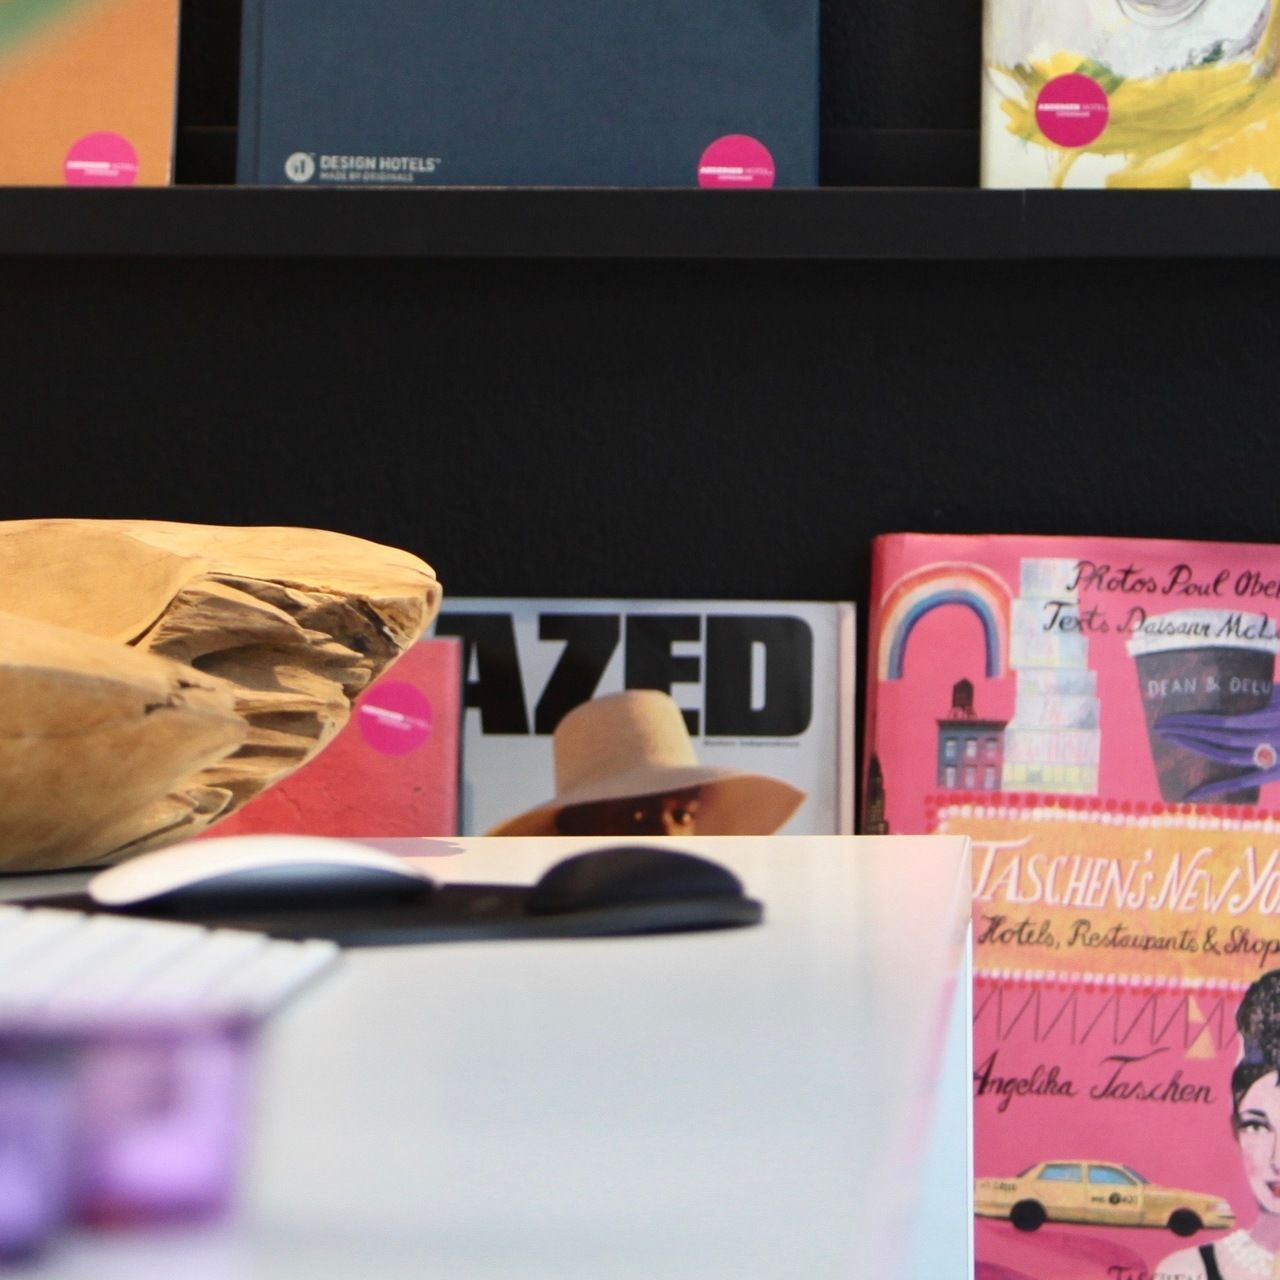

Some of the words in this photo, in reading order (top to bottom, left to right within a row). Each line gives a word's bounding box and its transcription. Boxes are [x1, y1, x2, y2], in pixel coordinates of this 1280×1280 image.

[319, 154, 377, 170] DESIGN
[1066, 560, 1157, 592] Photos
[1043, 600, 1110, 634] Texts
[1147, 678, 1196, 698] DEAN
[1067, 919, 1199, 952] Restaurants
[1089, 1047, 1217, 1104] Taschen
